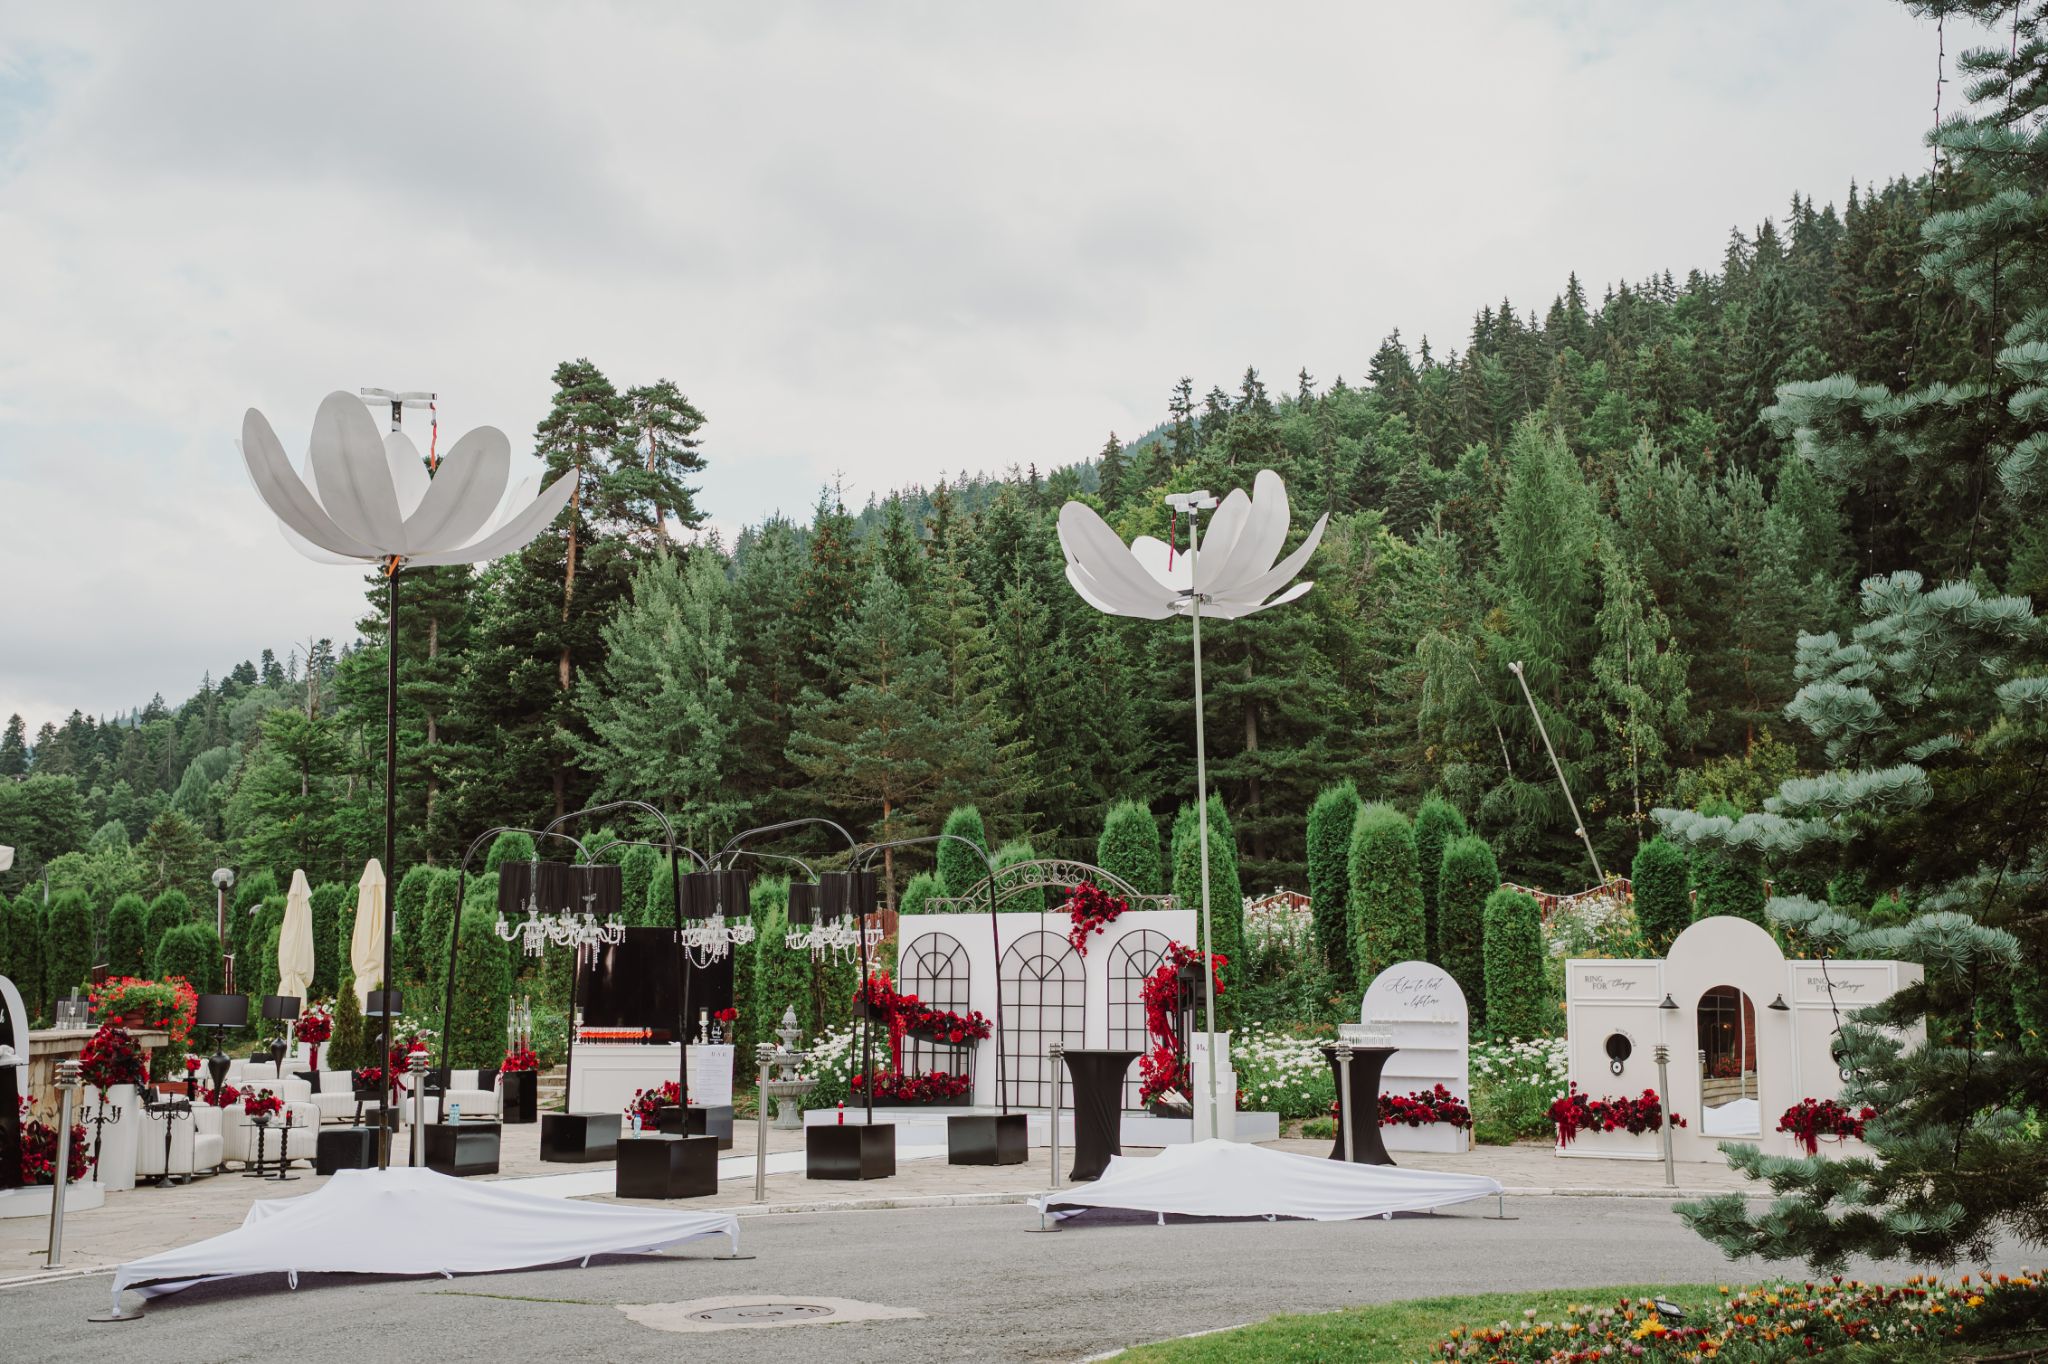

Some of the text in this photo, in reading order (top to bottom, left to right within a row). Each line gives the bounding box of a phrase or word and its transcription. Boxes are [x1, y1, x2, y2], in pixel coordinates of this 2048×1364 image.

[1584, 975, 1603, 983] RING
[1807, 977, 1828, 985] RING
[1592, 982, 1608, 991] FOR
